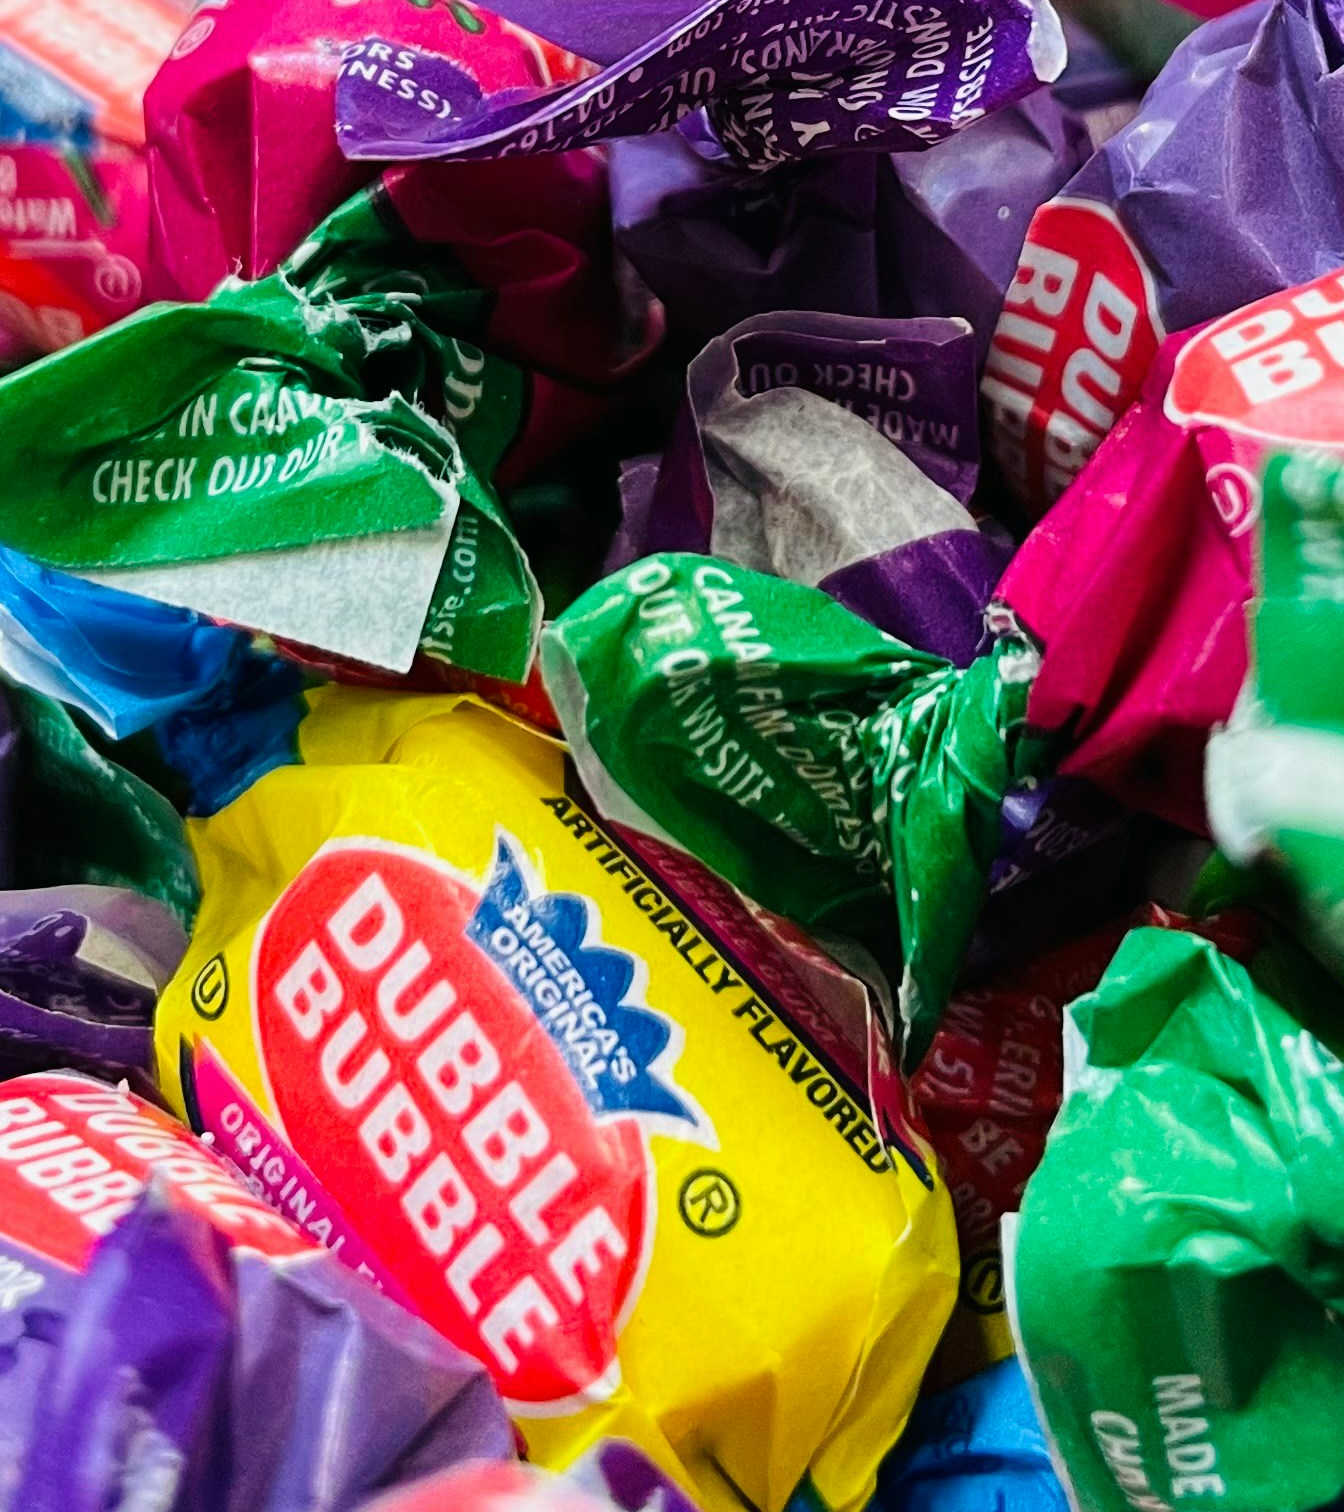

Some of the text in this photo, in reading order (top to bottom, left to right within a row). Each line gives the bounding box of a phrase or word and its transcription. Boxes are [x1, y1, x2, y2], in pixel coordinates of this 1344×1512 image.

[179, 393, 218, 438] IN
[812, 362, 917, 401] CHECK
[93, 458, 197, 505] CHECK
[276, 424, 346, 484] OUR
[626, 561, 693, 645] OUT
[487, 925, 618, 1090] ORIGINAL
[502, 900, 637, 1085] AMERICA'S
[540, 791, 891, 1178] ARTIFICIALLY FLAVORED
[274, 938, 558, 1377] BUBBLE
[326, 871, 630, 1304] DUBBLE
[1152, 1372, 1225, 1498] MADE
